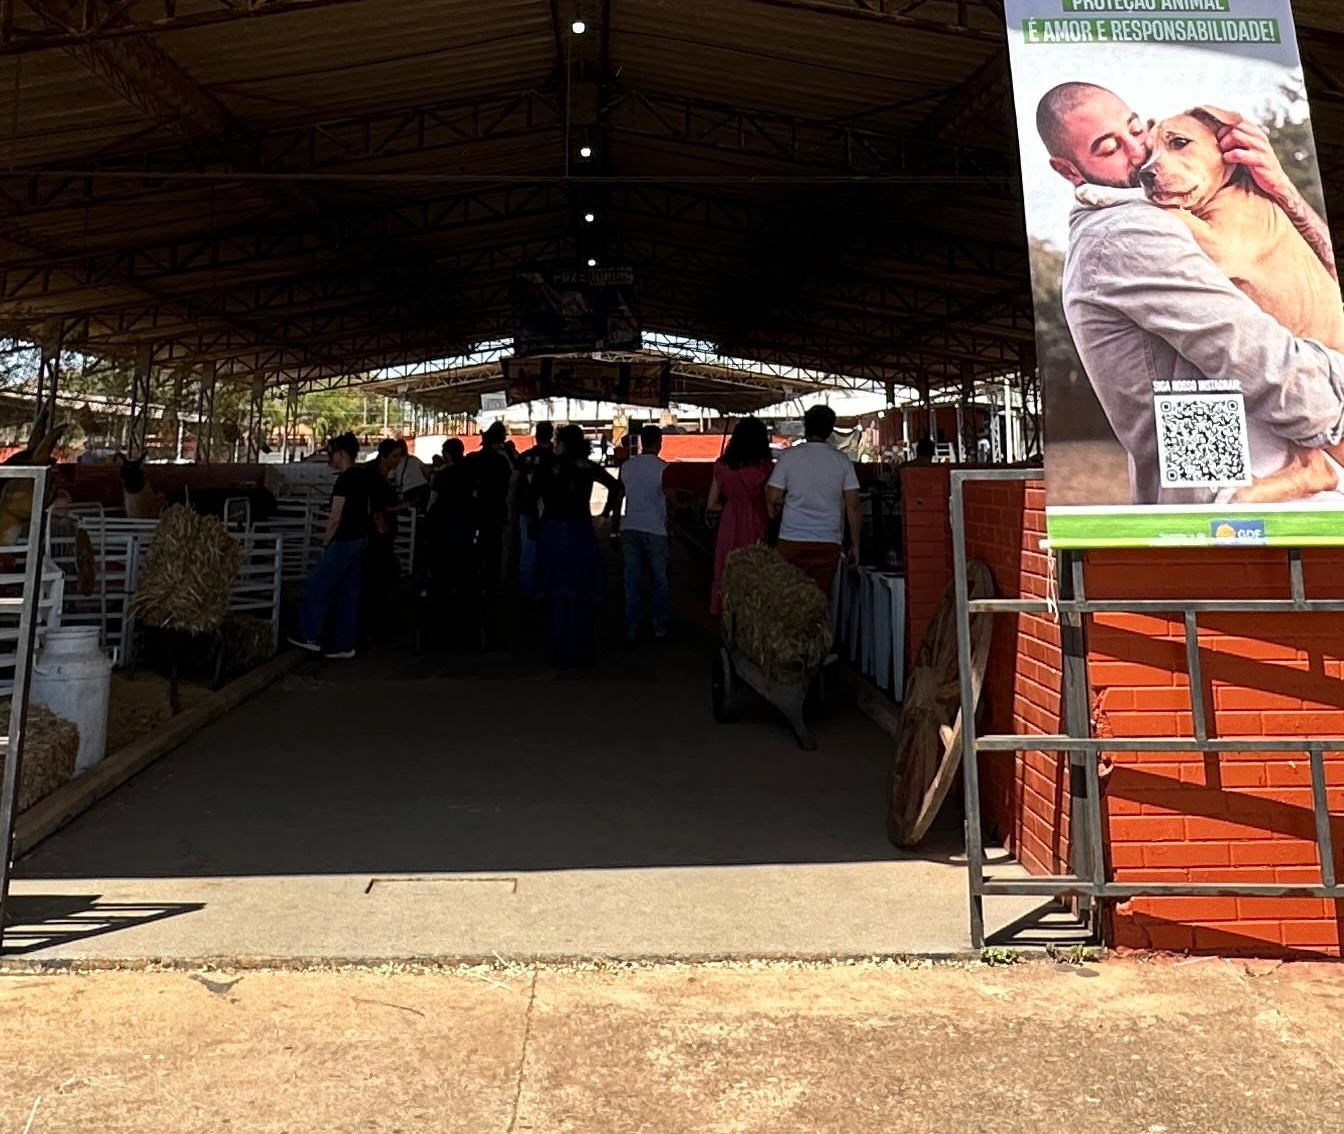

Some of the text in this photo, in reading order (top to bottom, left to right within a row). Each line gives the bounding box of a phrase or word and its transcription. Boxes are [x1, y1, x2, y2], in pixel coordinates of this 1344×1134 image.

[1028, 17, 1276, 42] É AMOR E RESPONSABILIDADE!
